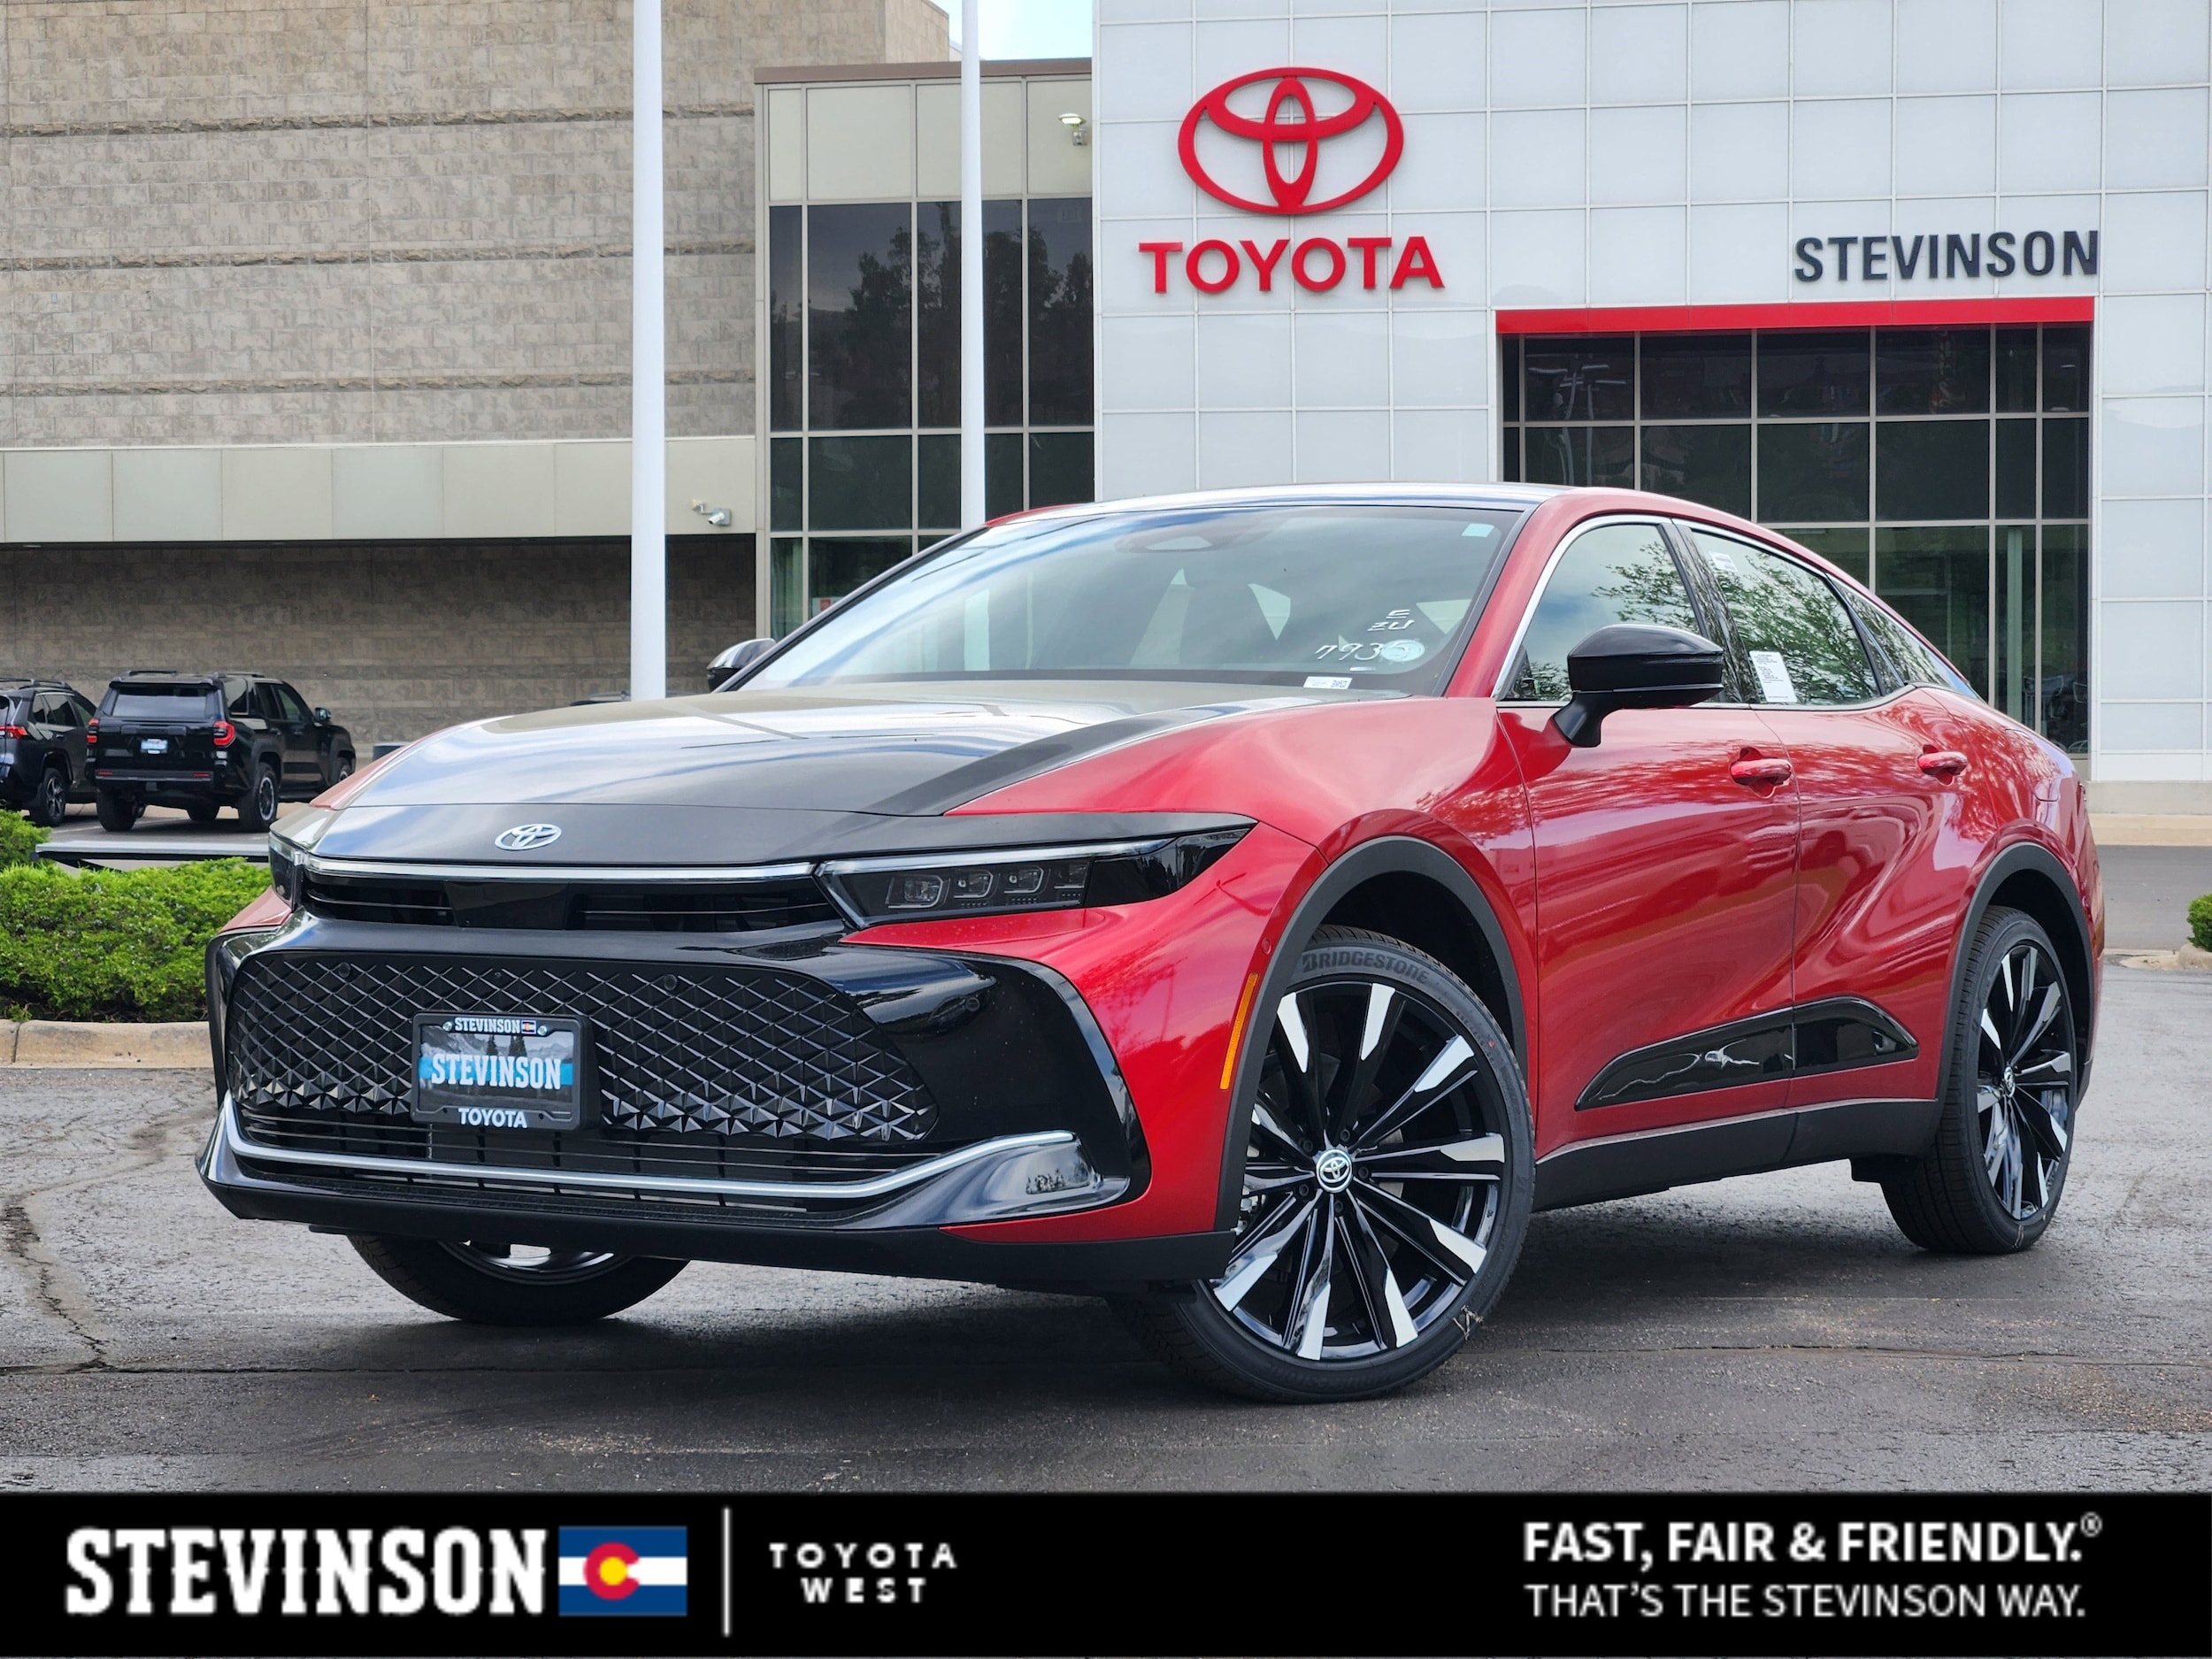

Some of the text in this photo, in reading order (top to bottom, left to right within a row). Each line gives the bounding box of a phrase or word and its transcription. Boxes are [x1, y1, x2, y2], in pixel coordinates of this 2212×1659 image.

[1139, 235, 1444, 294] TOYOTA
[1795, 230, 2099, 282] STEVINSON
[1302, 950, 1431, 984] BRIDGESTONE
[454, 1017, 521, 1034] STEVINSON
[431, 1053, 562, 1090] STEVINSON
[458, 1107, 527, 1129] TOYOTA
